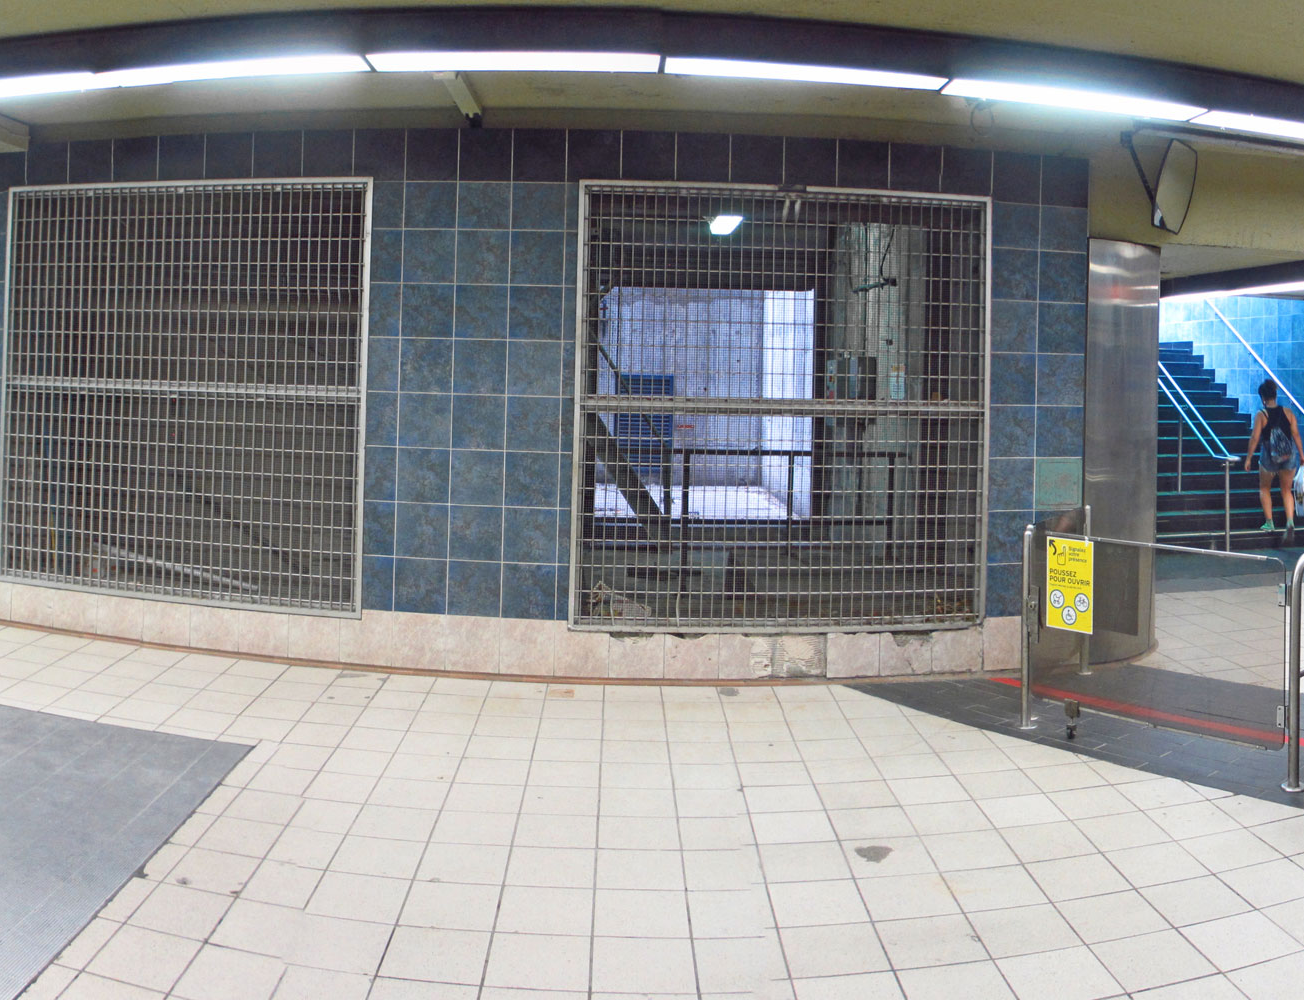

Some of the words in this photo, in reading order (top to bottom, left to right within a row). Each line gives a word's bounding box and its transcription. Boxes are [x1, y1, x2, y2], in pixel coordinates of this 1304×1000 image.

[1049, 568, 1077, 578] POUSSEZ
[1049, 575, 1066, 583] POUR
[1067, 578, 1091, 586] OUVRIR
